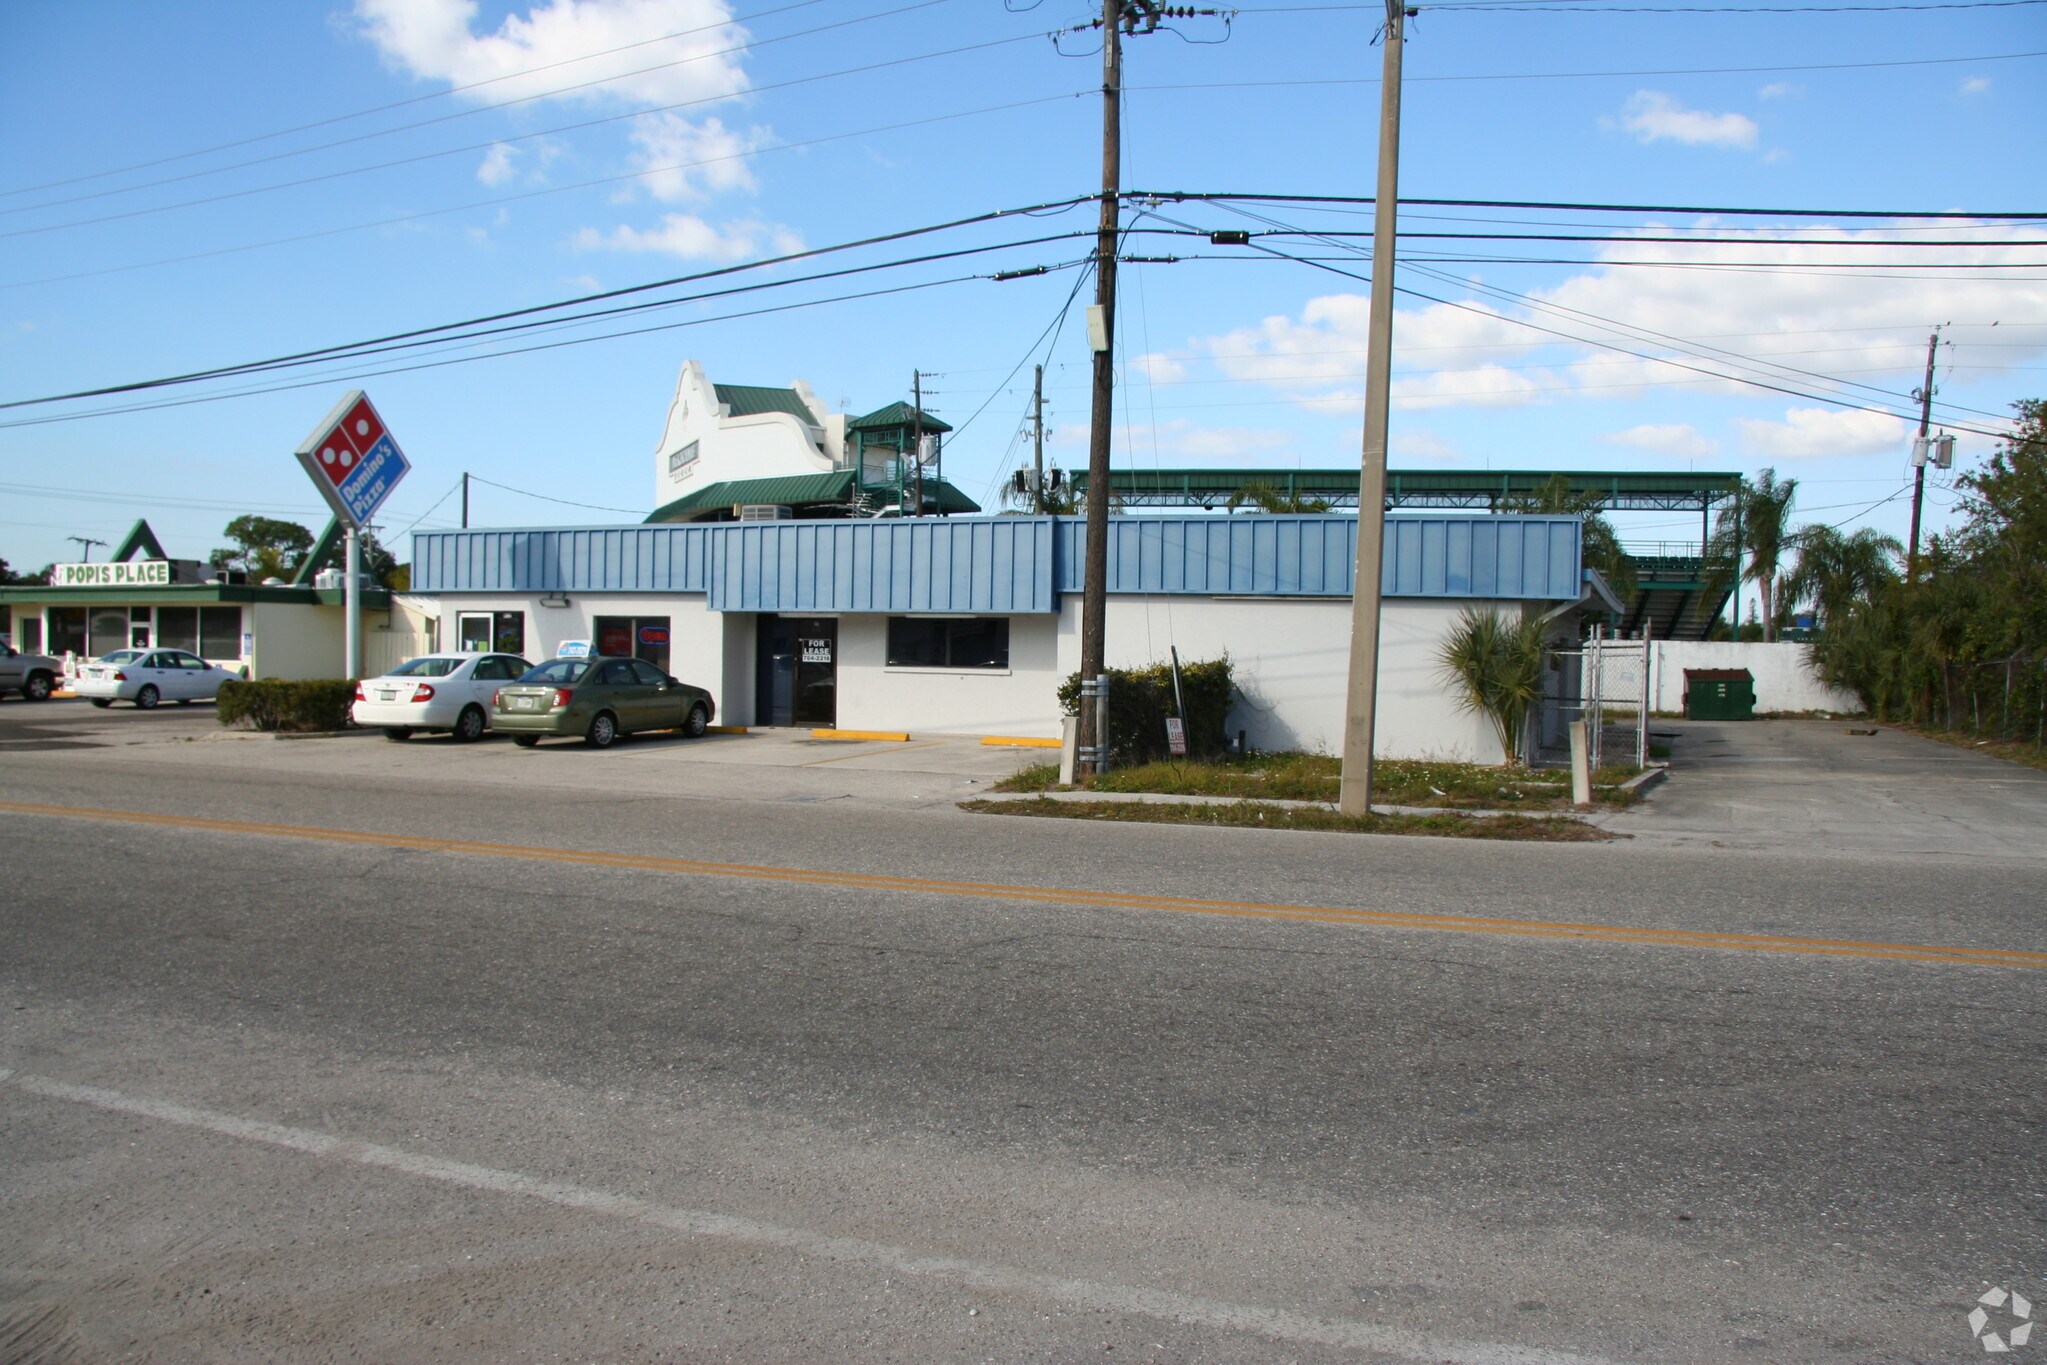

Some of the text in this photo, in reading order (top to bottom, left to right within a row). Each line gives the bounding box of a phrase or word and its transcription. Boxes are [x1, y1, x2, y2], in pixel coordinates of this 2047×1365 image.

[342, 445, 392, 503] Domino's
[352, 480, 385, 518] Pizza
[115, 563, 167, 583] PLACE
[803, 647, 830, 655] LEASE
[1169, 719, 1180, 730] FOR
[1168, 731, 1184, 742] LEASE
